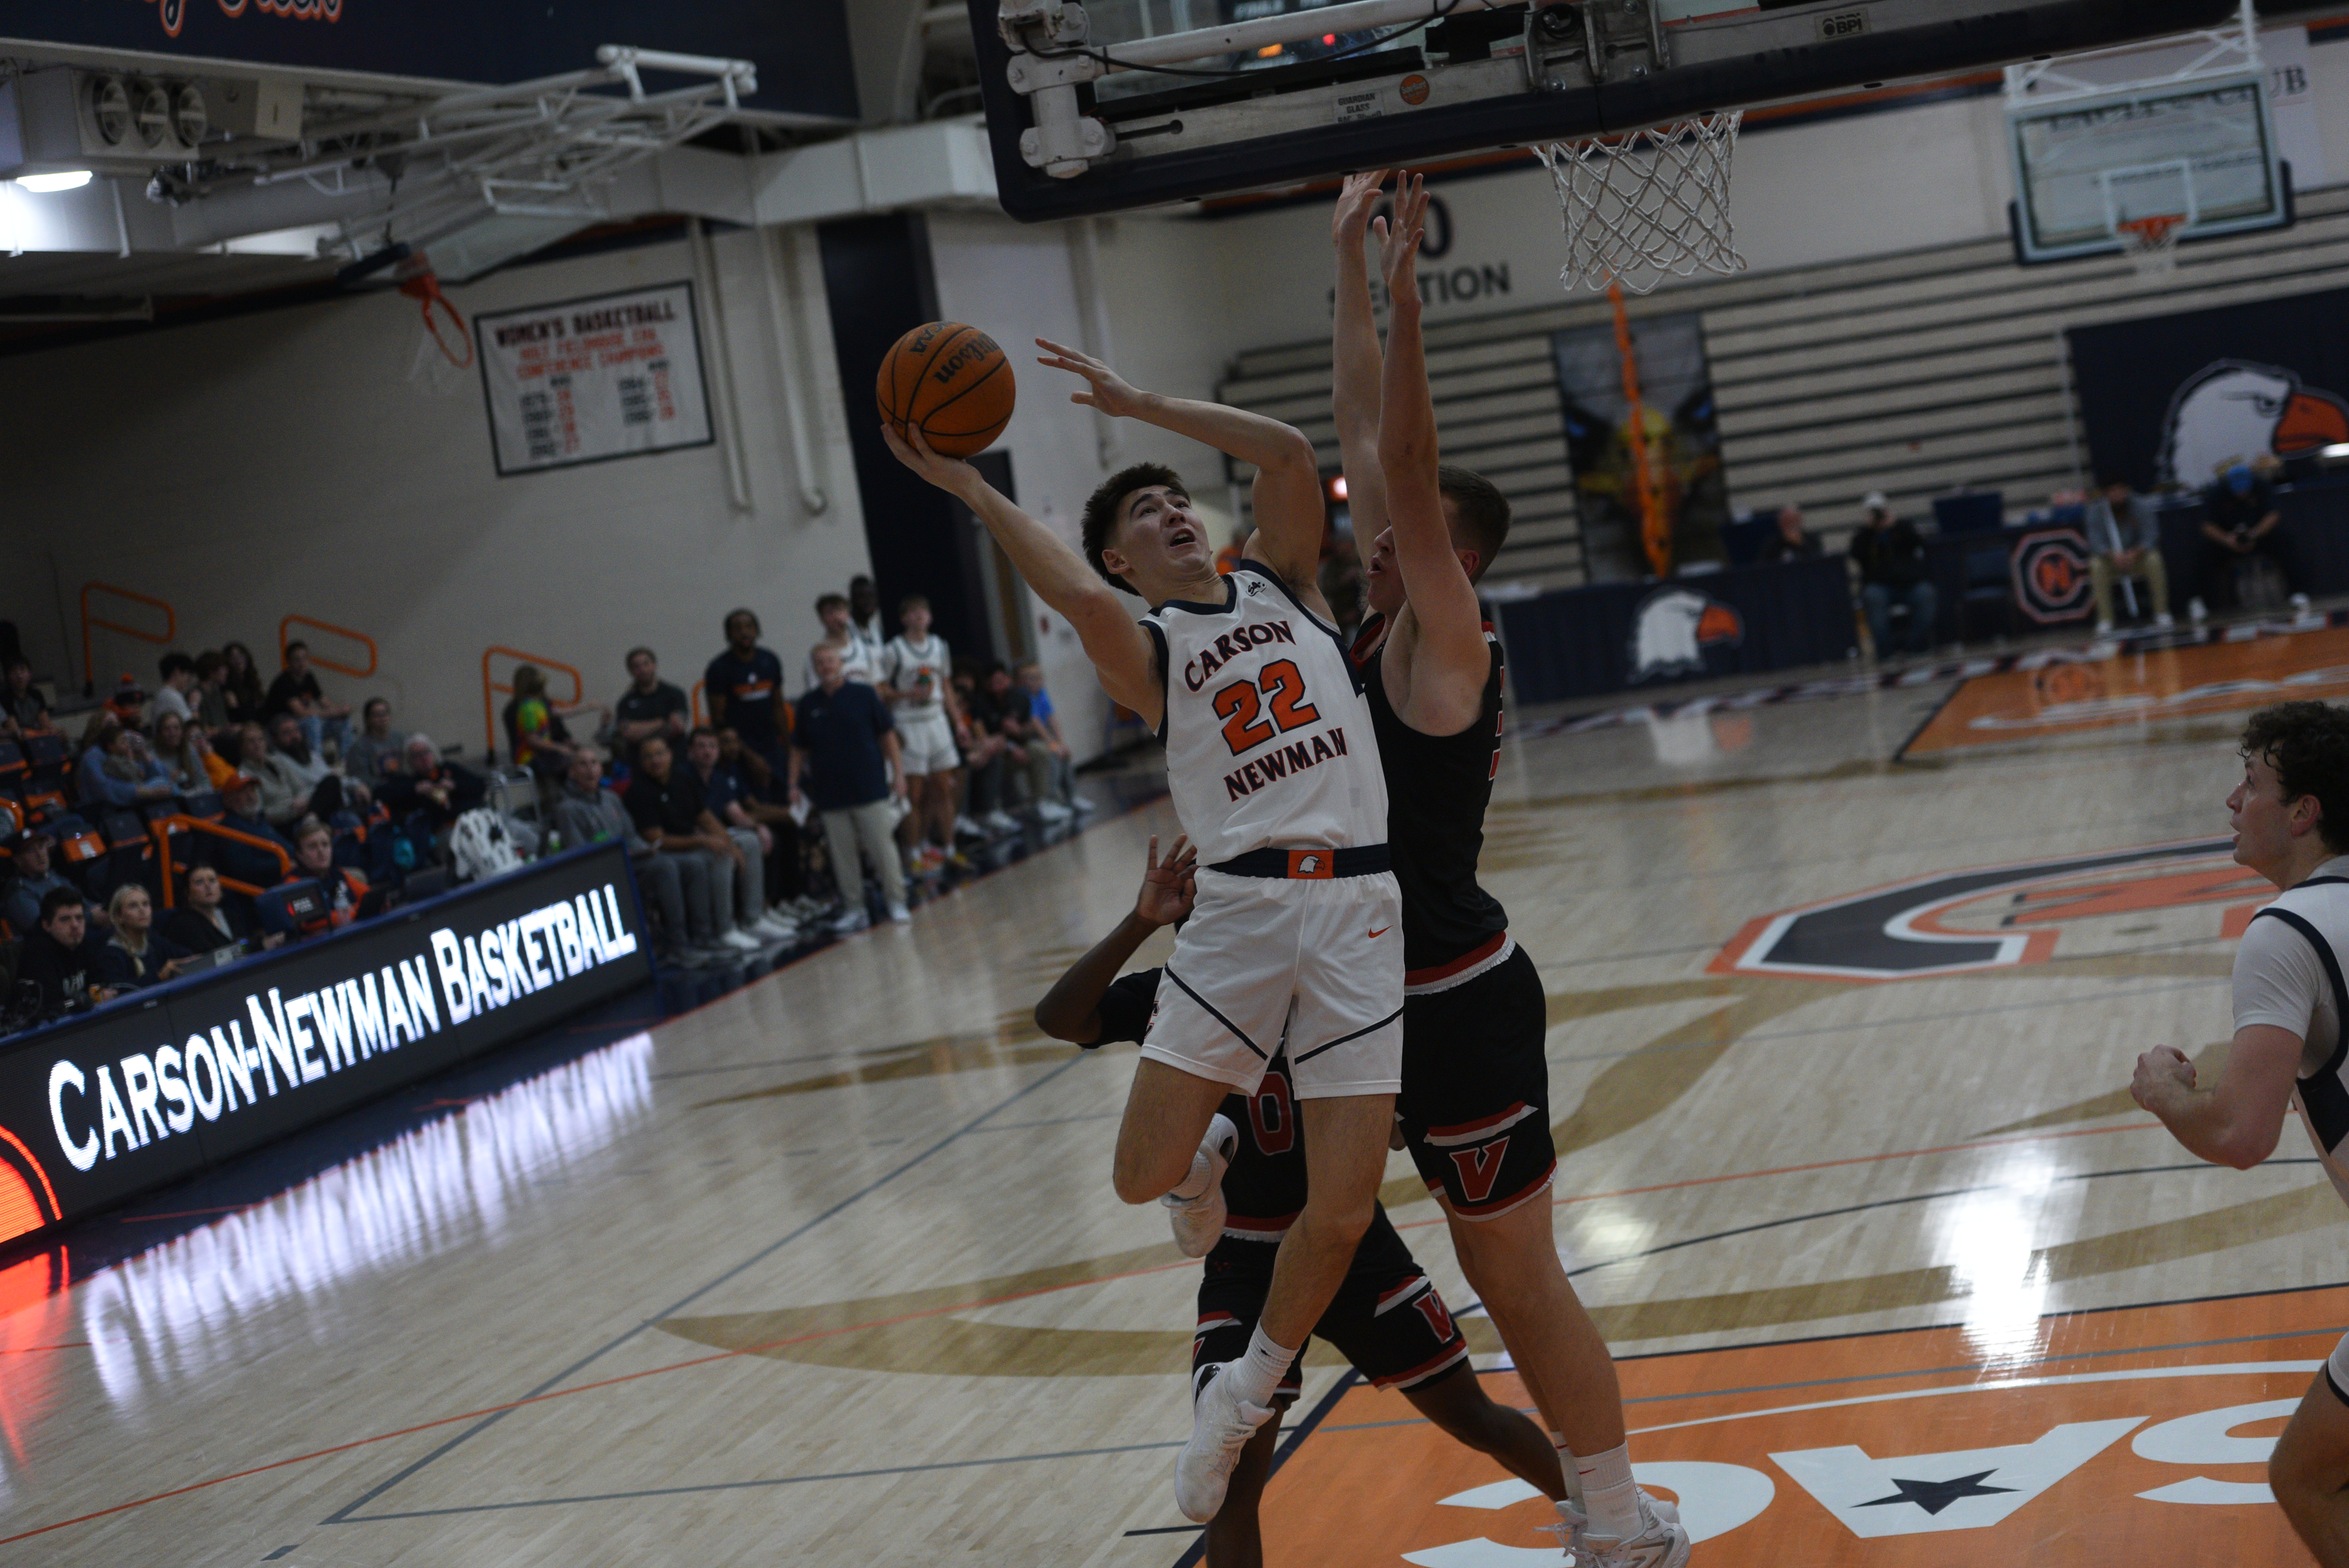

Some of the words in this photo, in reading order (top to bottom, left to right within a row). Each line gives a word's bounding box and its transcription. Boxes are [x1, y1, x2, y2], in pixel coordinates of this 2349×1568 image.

[1338, 92, 1376, 106] GUARDIAN
[1346, 102, 1371, 114] GLASS
[496, 315, 565, 348] WOMEN'S
[573, 300, 676, 335] BASKETBALL
[1184, 620, 1297, 693] CARSON
[1211, 658, 1322, 757] 22
[1223, 727, 1348, 803] NEWMAN
[430, 883, 638, 1026] BASKETBALL
[1448, 1135, 1511, 1202] V
